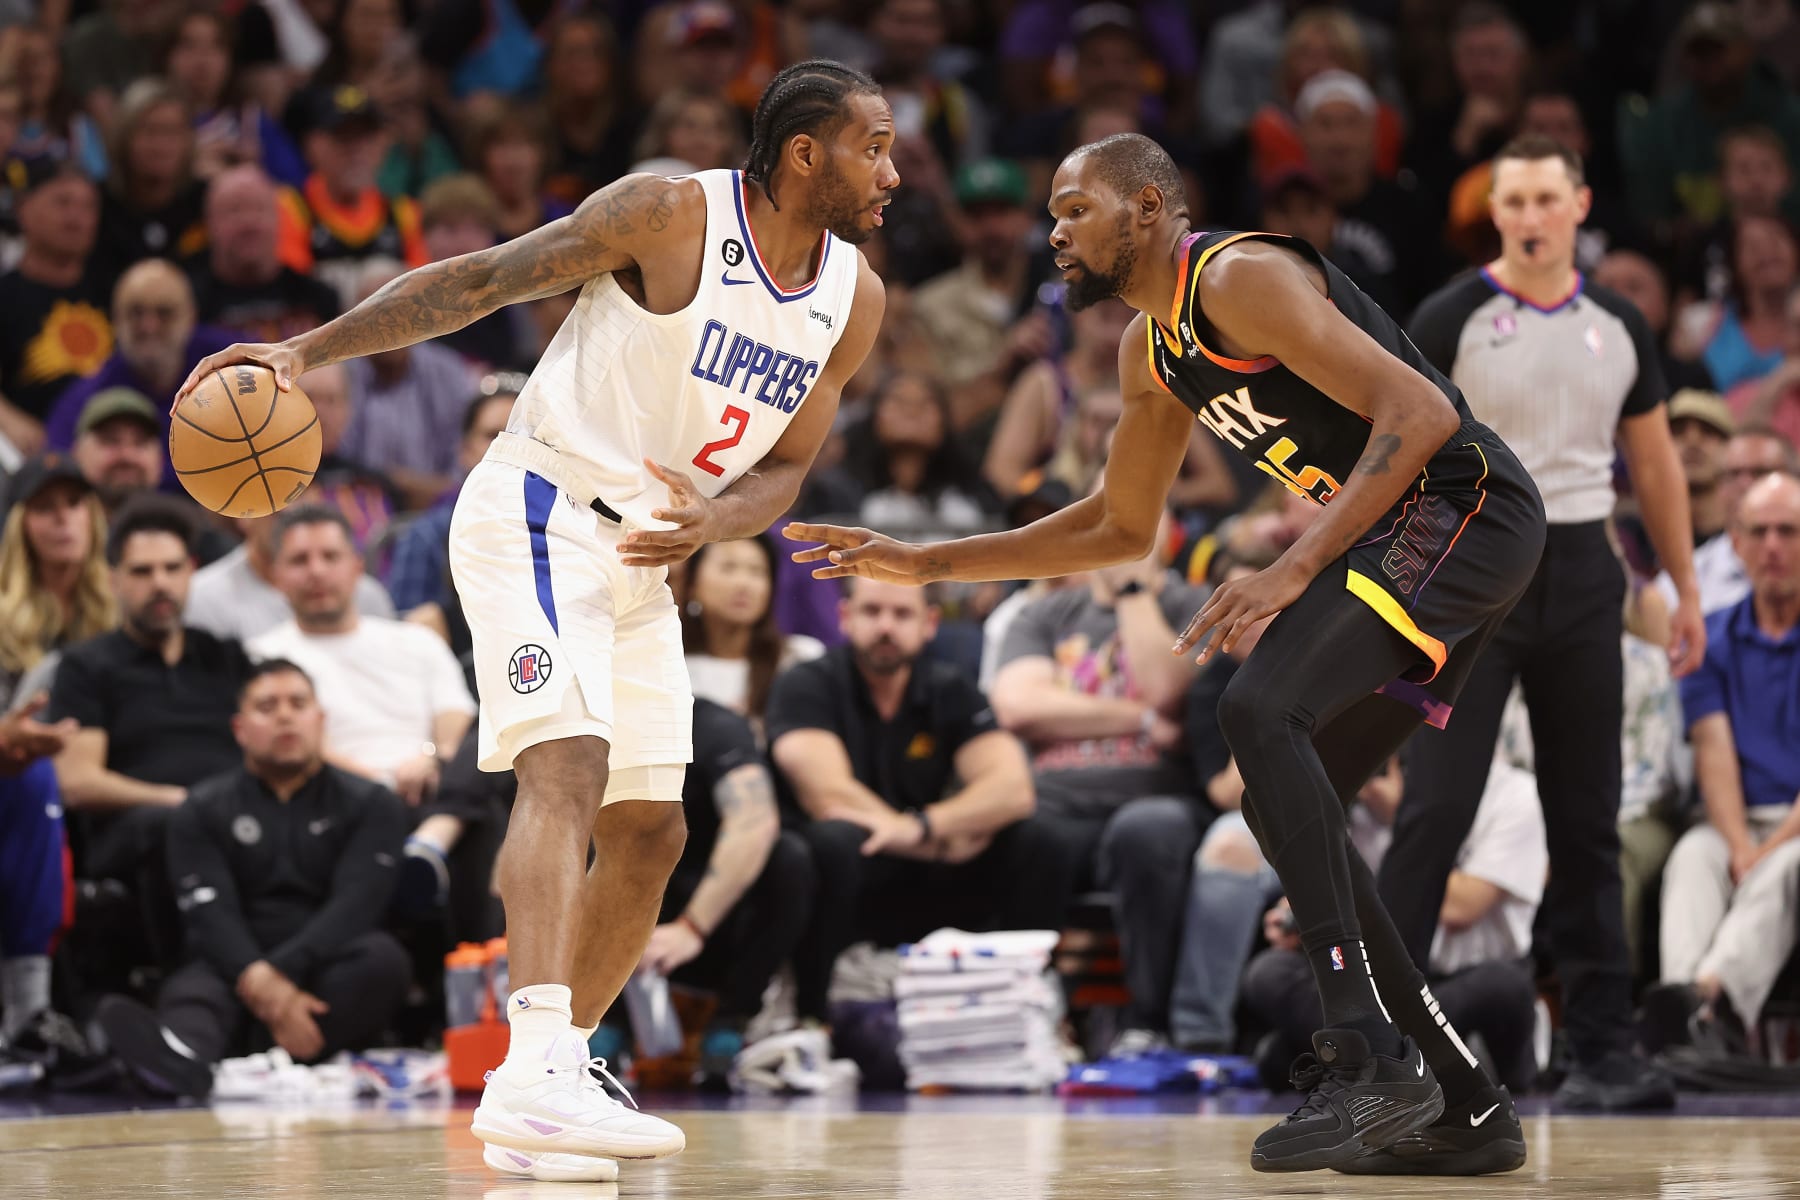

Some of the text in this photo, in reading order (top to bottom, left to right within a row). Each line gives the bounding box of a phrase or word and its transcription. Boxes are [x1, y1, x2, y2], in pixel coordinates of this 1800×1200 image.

[724, 241, 738, 263] 6
[691, 319, 818, 414] CLIPPERS
[692, 404, 750, 478] 2
